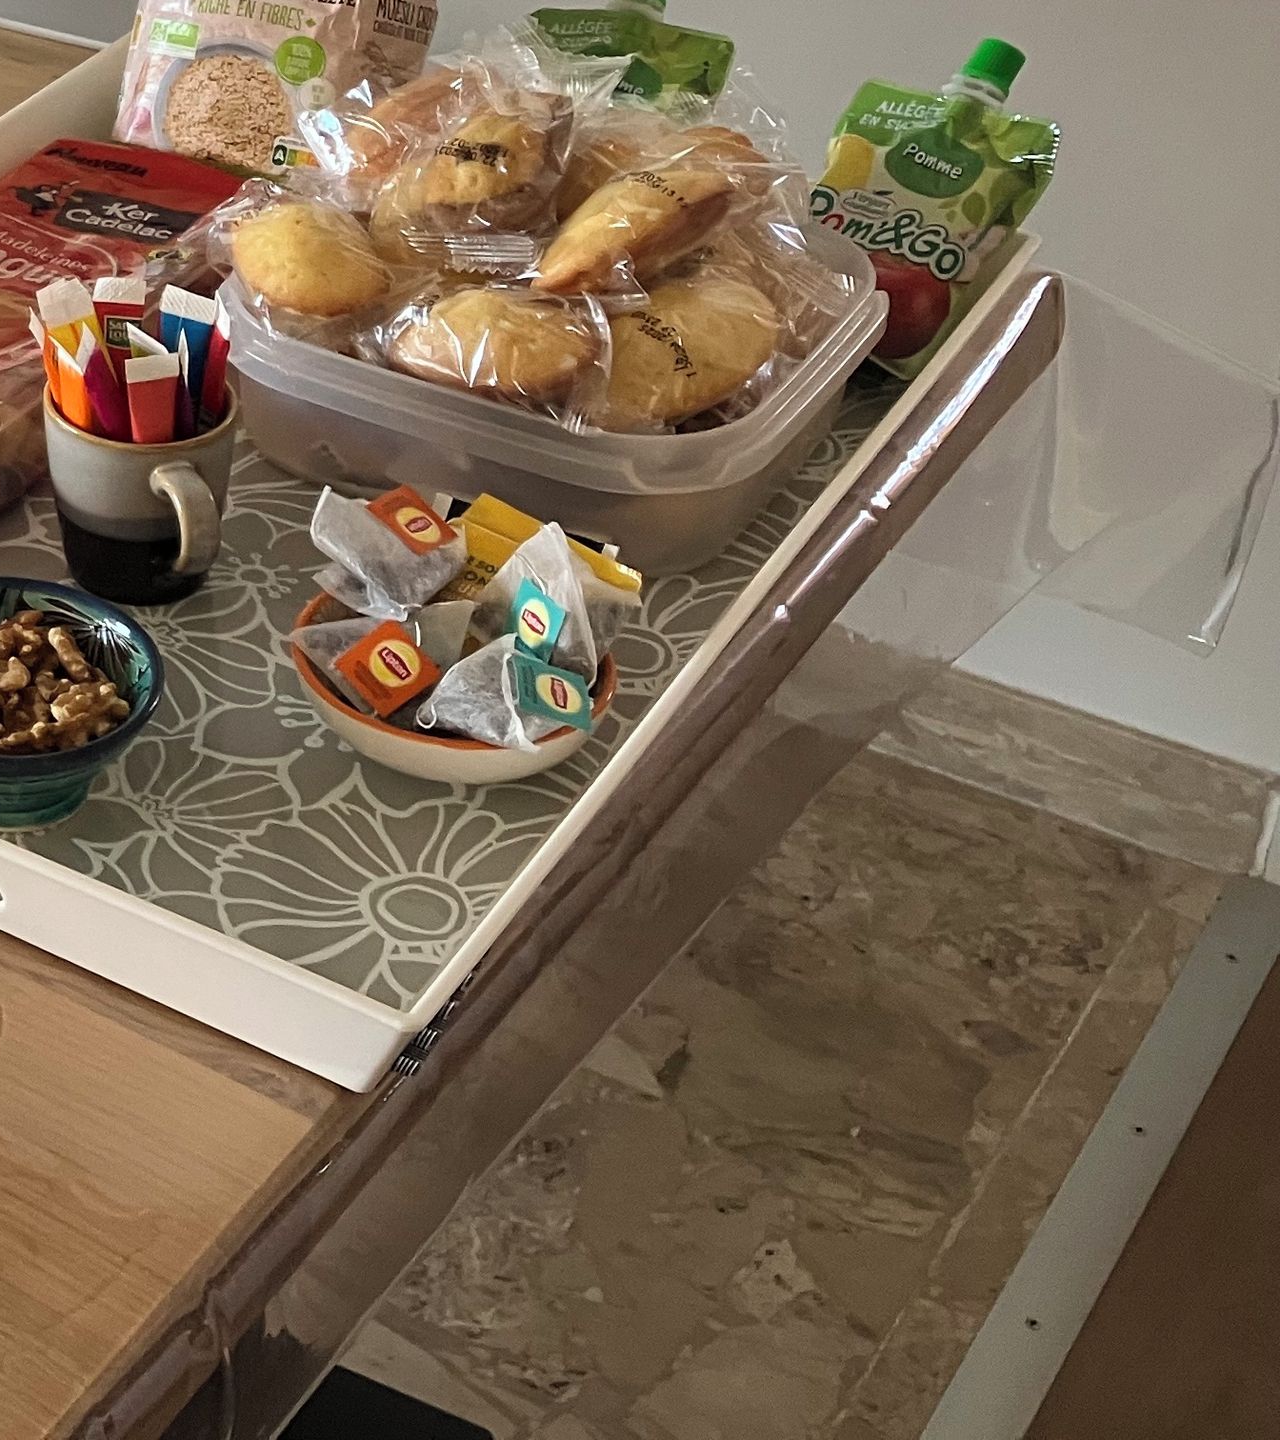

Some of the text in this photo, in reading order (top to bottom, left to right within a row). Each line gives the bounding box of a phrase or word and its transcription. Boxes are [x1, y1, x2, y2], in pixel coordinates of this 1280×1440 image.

[260, 2, 304, 32] FIBRES
[859, 113, 882, 127] EN
[902, 143, 964, 180] Pomme
[65, 208, 173, 240] Cadelac
[101, 202, 160, 222] Ker
